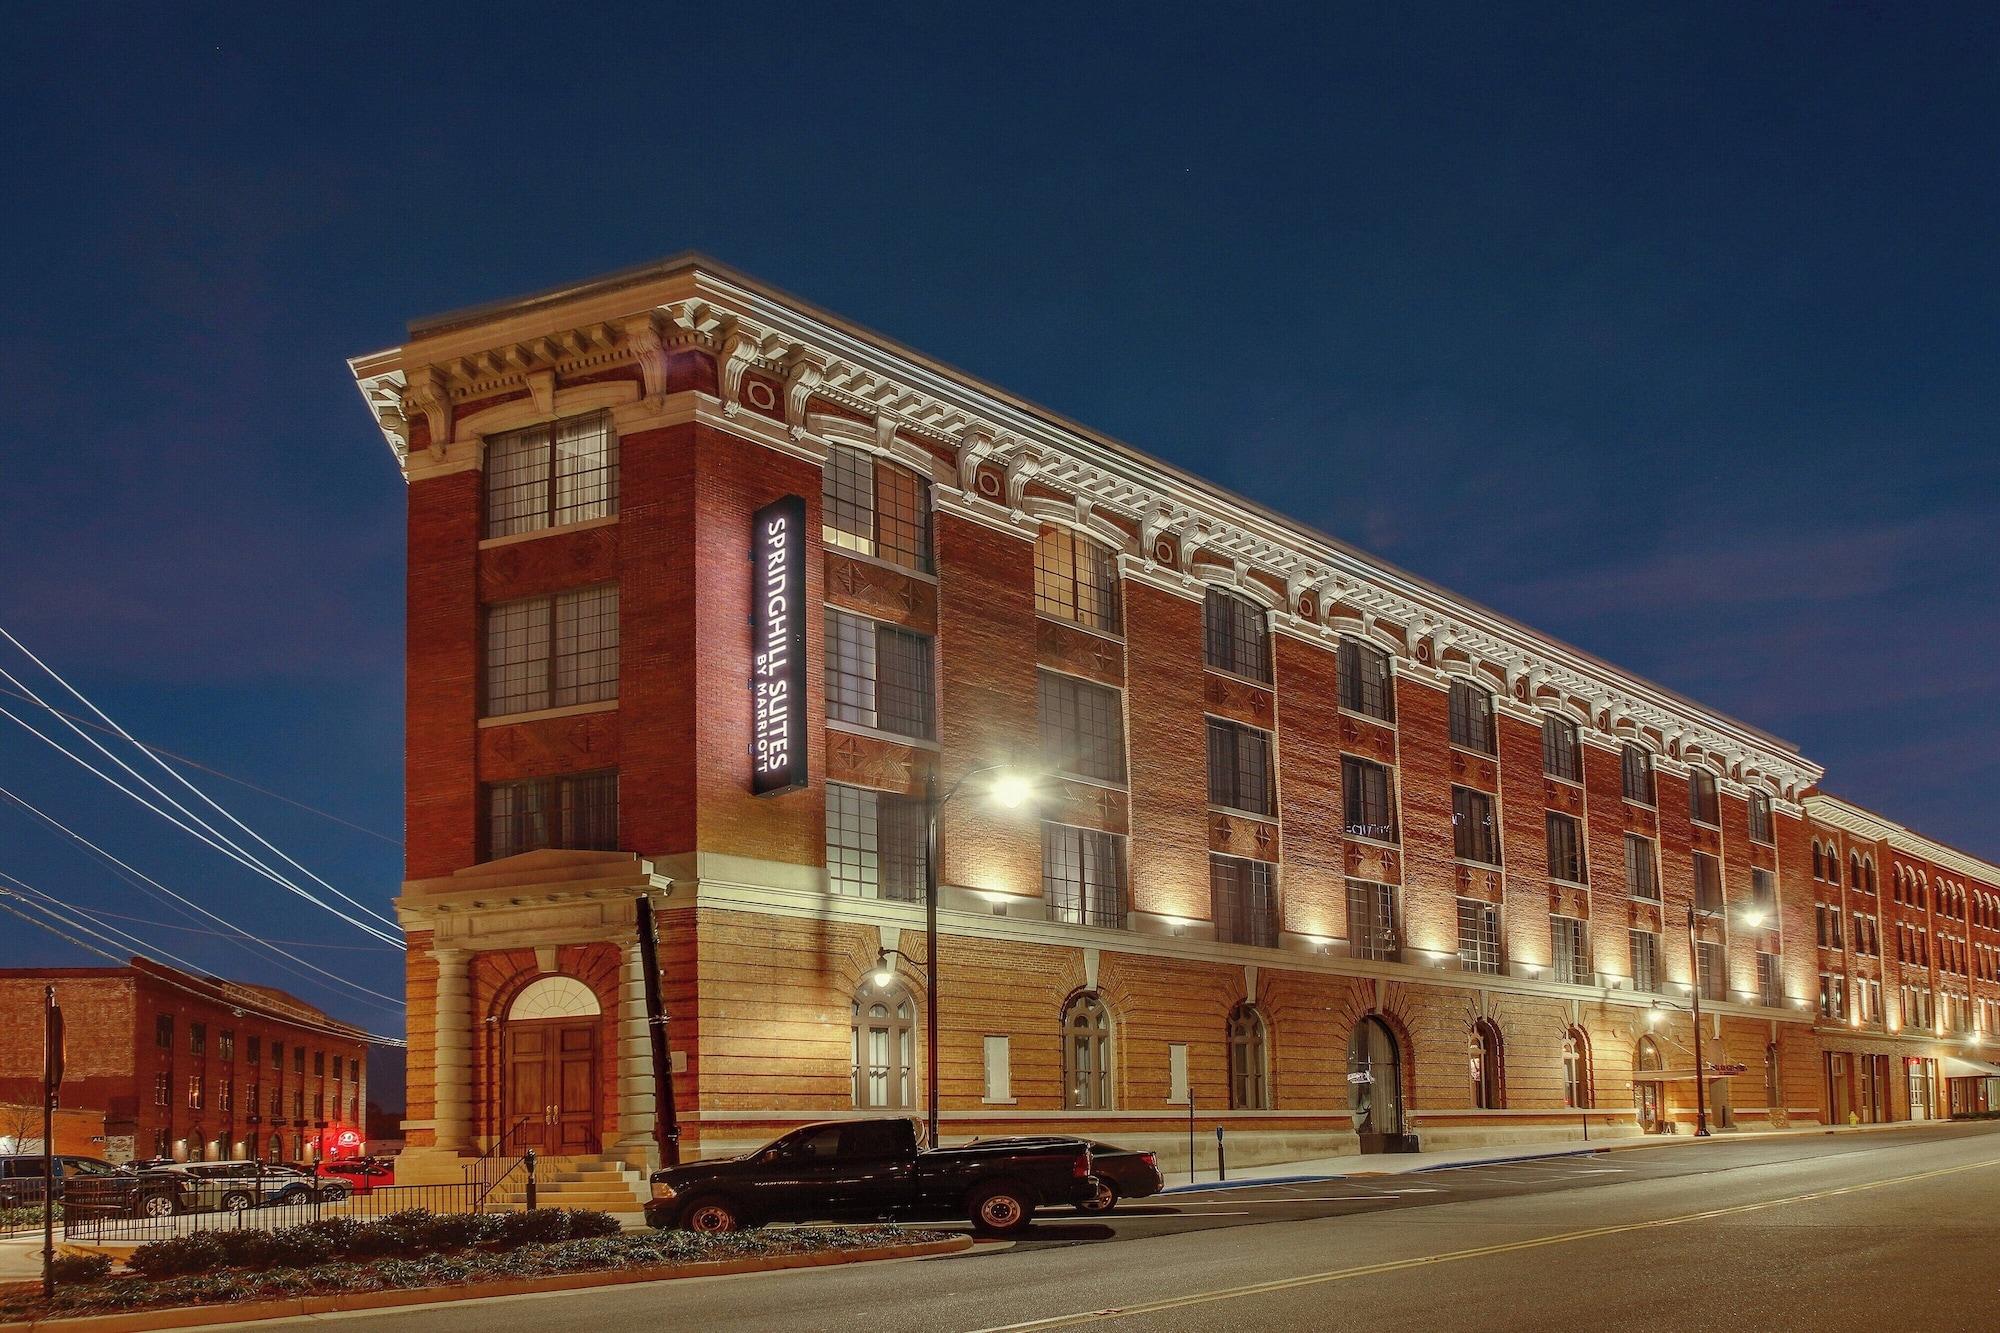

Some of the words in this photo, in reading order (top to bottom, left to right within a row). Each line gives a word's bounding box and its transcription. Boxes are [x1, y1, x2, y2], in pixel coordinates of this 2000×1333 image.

[768, 517, 787, 677] SPRINGHILL
[757, 654, 768, 675] BY
[757, 682, 768, 773] MARRIOTT
[768, 680, 788, 769] SUITES
